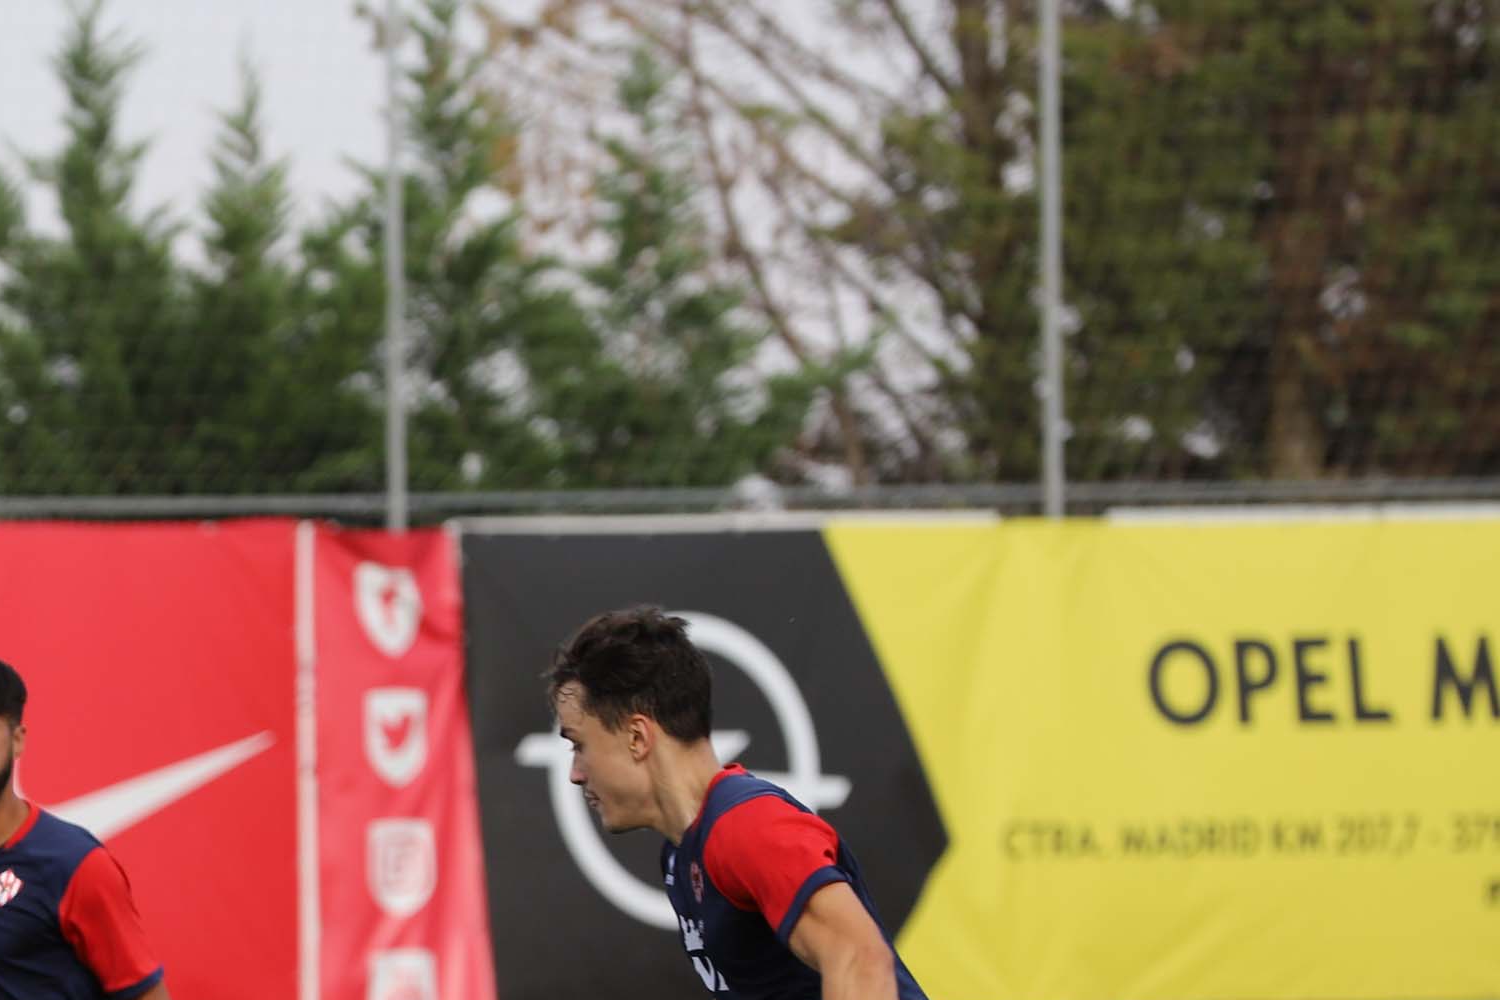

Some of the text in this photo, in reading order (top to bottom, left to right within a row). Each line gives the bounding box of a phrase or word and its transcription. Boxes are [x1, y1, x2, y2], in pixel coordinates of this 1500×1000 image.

[1148, 635, 1500, 727] OPEL M
[1118, 816, 1262, 858] MADRID
[1271, 814, 1328, 856] KM
